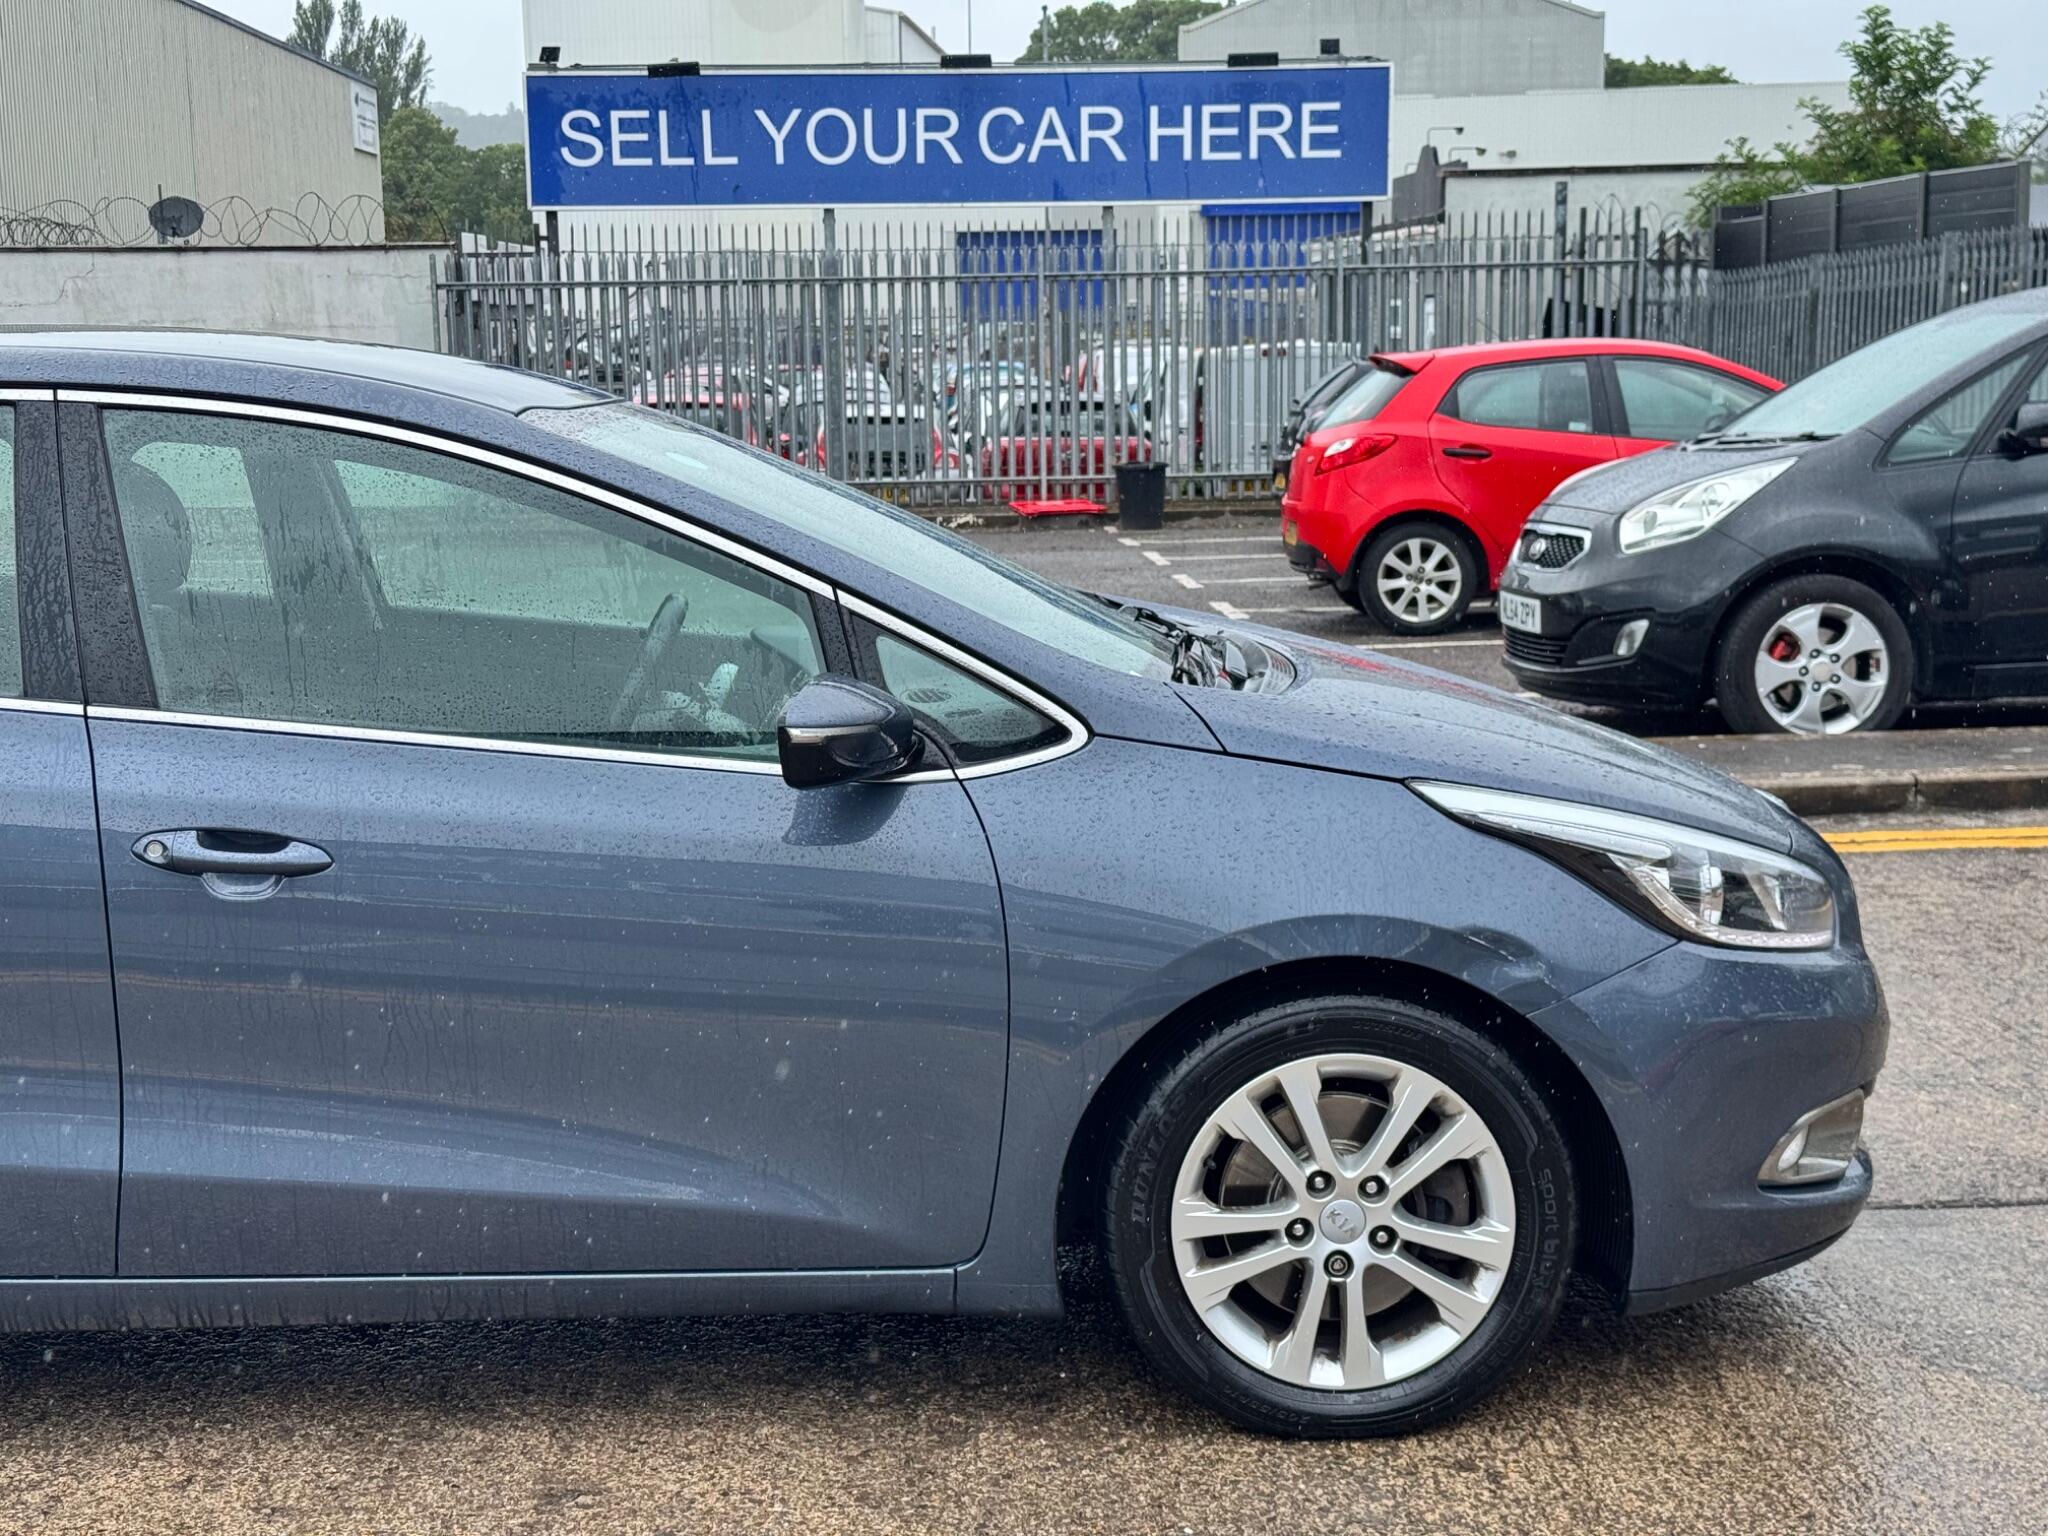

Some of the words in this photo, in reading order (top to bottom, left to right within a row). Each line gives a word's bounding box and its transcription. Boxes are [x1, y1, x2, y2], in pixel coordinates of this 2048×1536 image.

[560, 109, 738, 167] SELL
[754, 107, 963, 166] YOUR
[978, 105, 1127, 164] CAR
[1150, 102, 1343, 162] HERE
[1520, 602, 1537, 628] ZPY
[1131, 1092, 1187, 1223] DUNLOP
[1326, 1207, 1357, 1238] KIA
